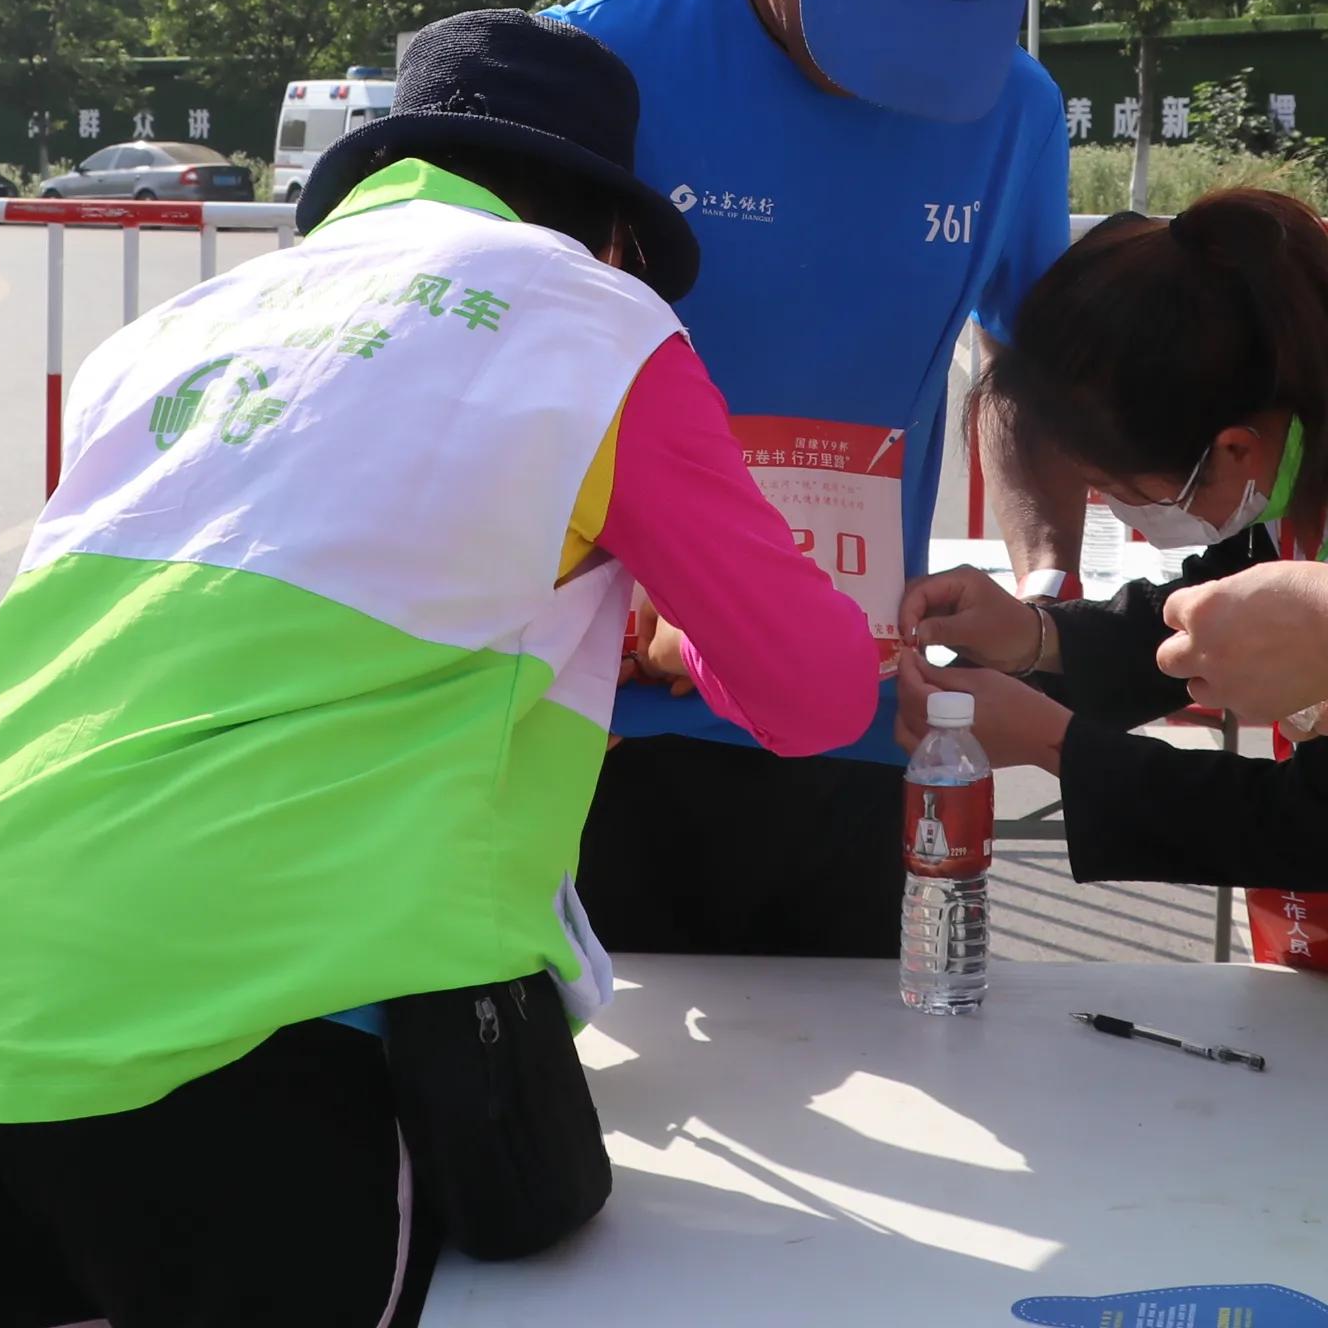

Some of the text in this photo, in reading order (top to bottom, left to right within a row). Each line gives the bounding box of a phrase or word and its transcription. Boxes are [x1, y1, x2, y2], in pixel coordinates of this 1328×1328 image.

[1066, 92, 1297, 140] 养成新惯
[701, 208, 725, 218] BANK
[727, 211, 739, 219] OF
[702, 190, 775, 216] 江苏银行
